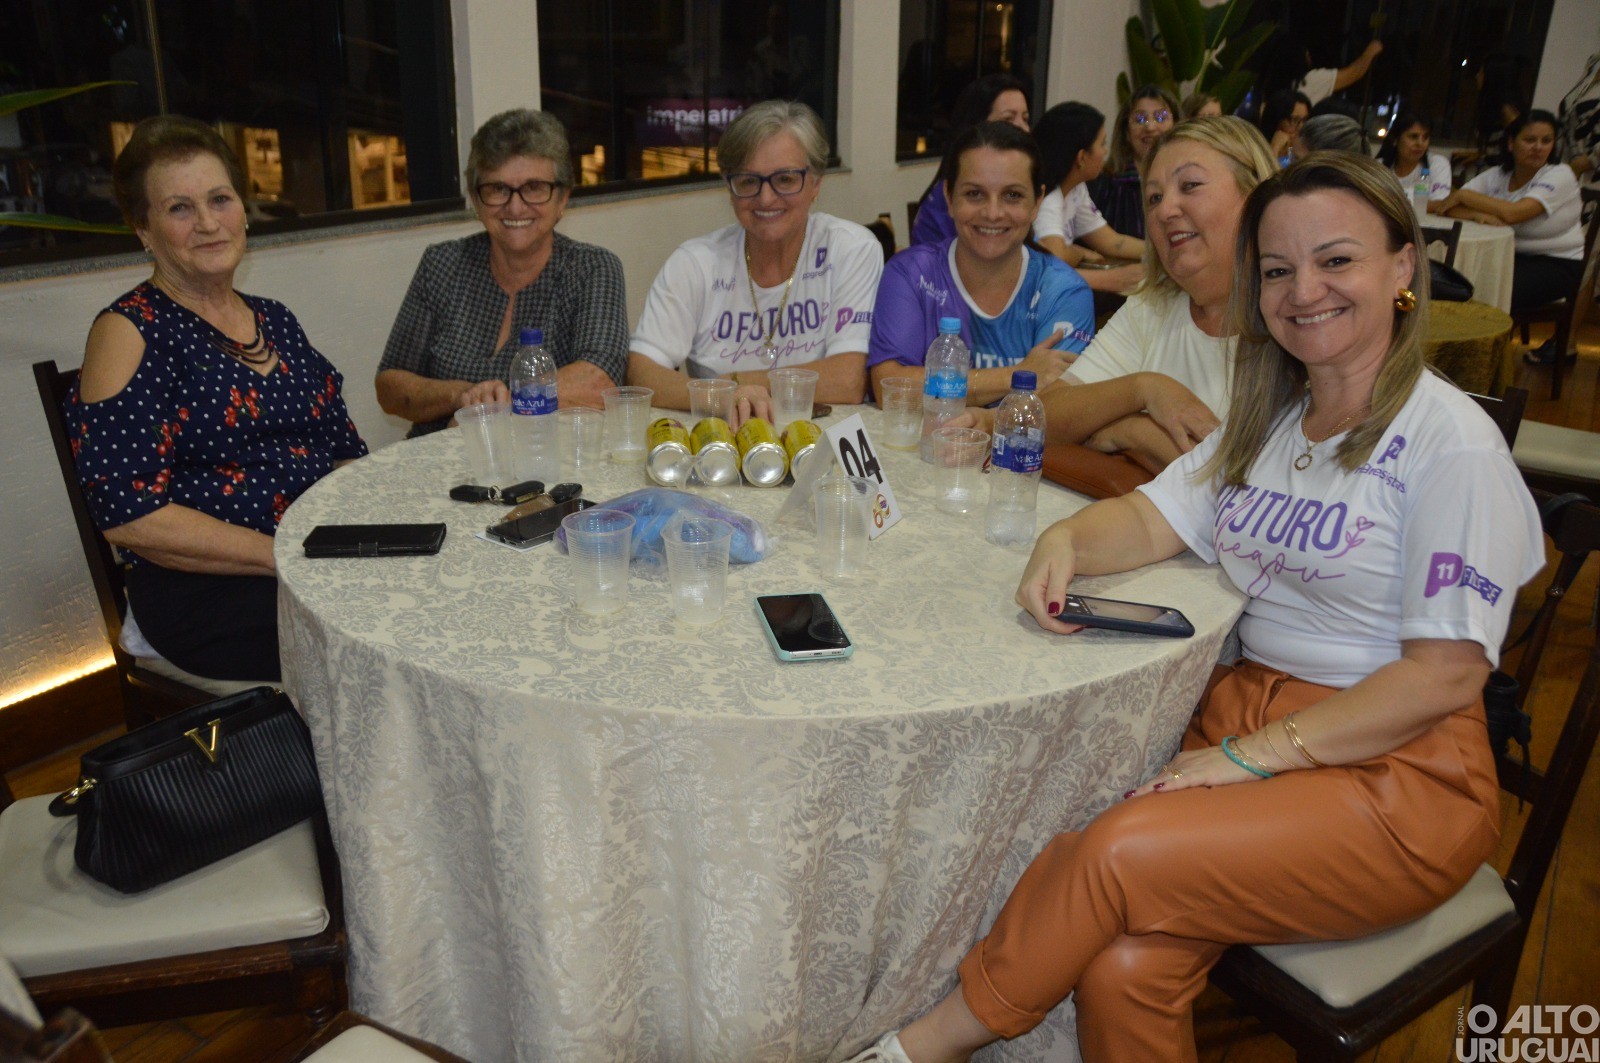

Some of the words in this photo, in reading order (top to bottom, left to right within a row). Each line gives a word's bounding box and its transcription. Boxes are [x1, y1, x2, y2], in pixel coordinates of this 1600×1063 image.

[717, 310, 733, 339] O
[735, 298, 820, 343] FUTURO
[839, 428, 883, 494] 04
[1213, 512, 1346, 598] hegou
